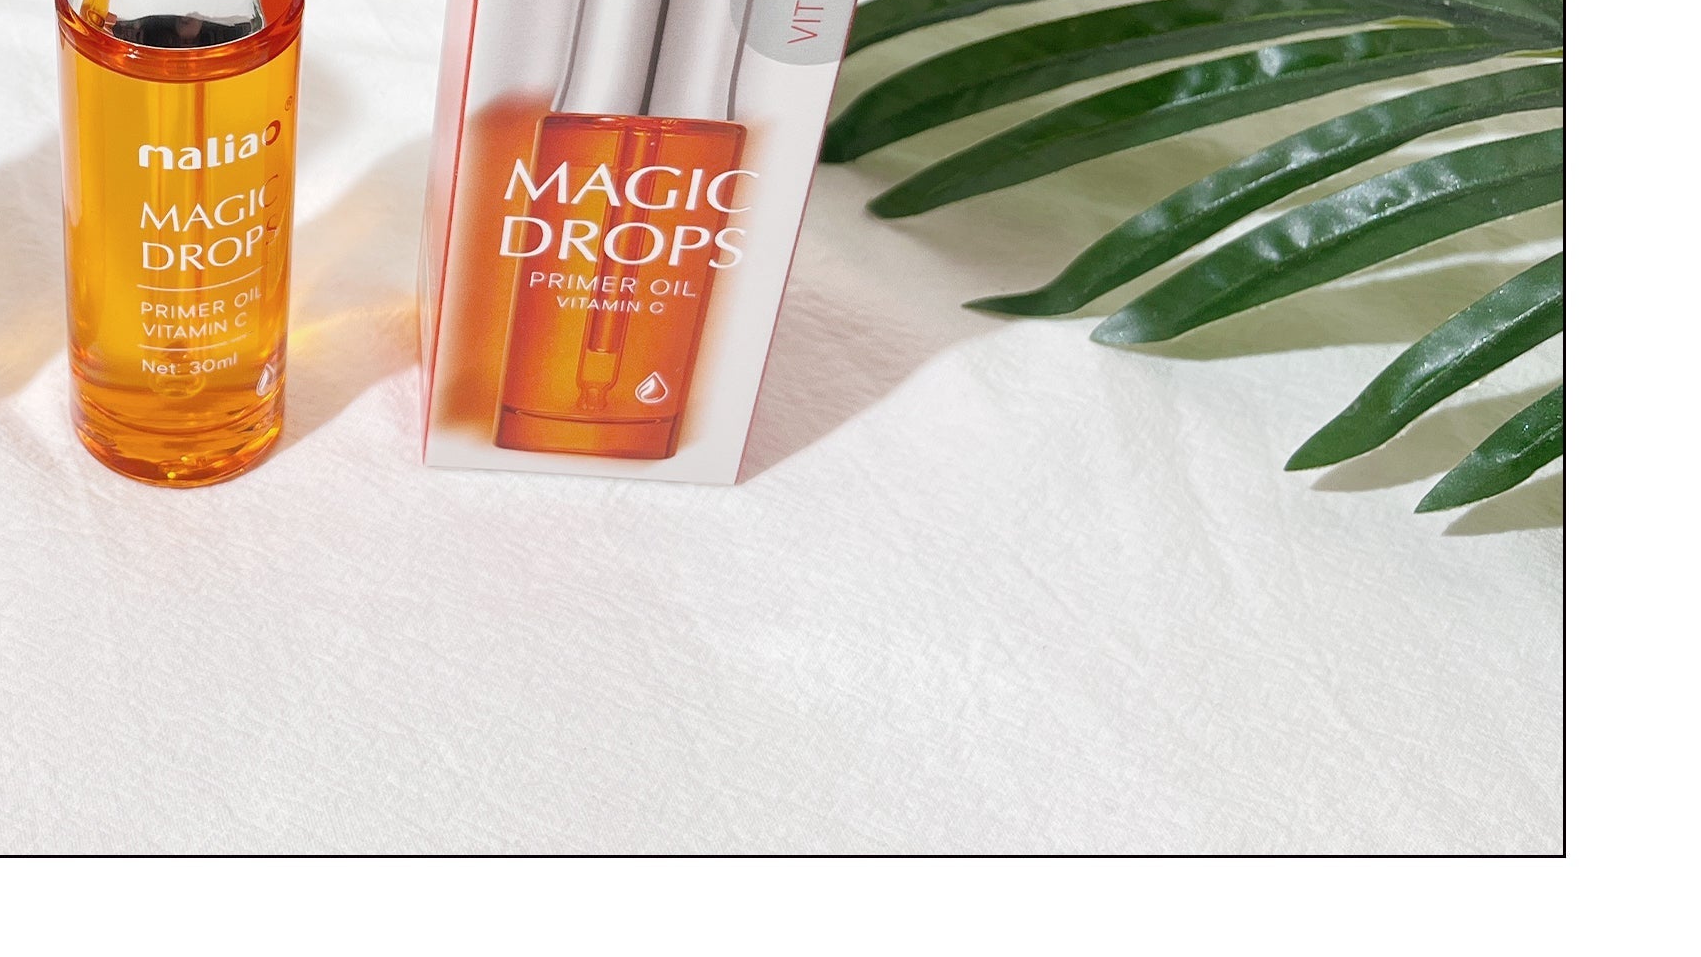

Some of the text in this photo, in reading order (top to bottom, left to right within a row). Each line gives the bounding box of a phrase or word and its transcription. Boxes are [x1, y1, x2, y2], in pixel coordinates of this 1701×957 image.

[787, 0, 824, 44] VIT
[137, 120, 281, 170] maliao
[140, 174, 279, 232] MAGIC
[503, 158, 760, 214] MAGIC
[499, 215, 748, 270] DROPS
[140, 286, 262, 320] PRIMER OIL
[529, 271, 697, 298] PRIMER OIL
[556, 295, 665, 314] VITAMIN C
[141, 312, 248, 339] VITAMIN C
[189, 351, 238, 375] 30ml
